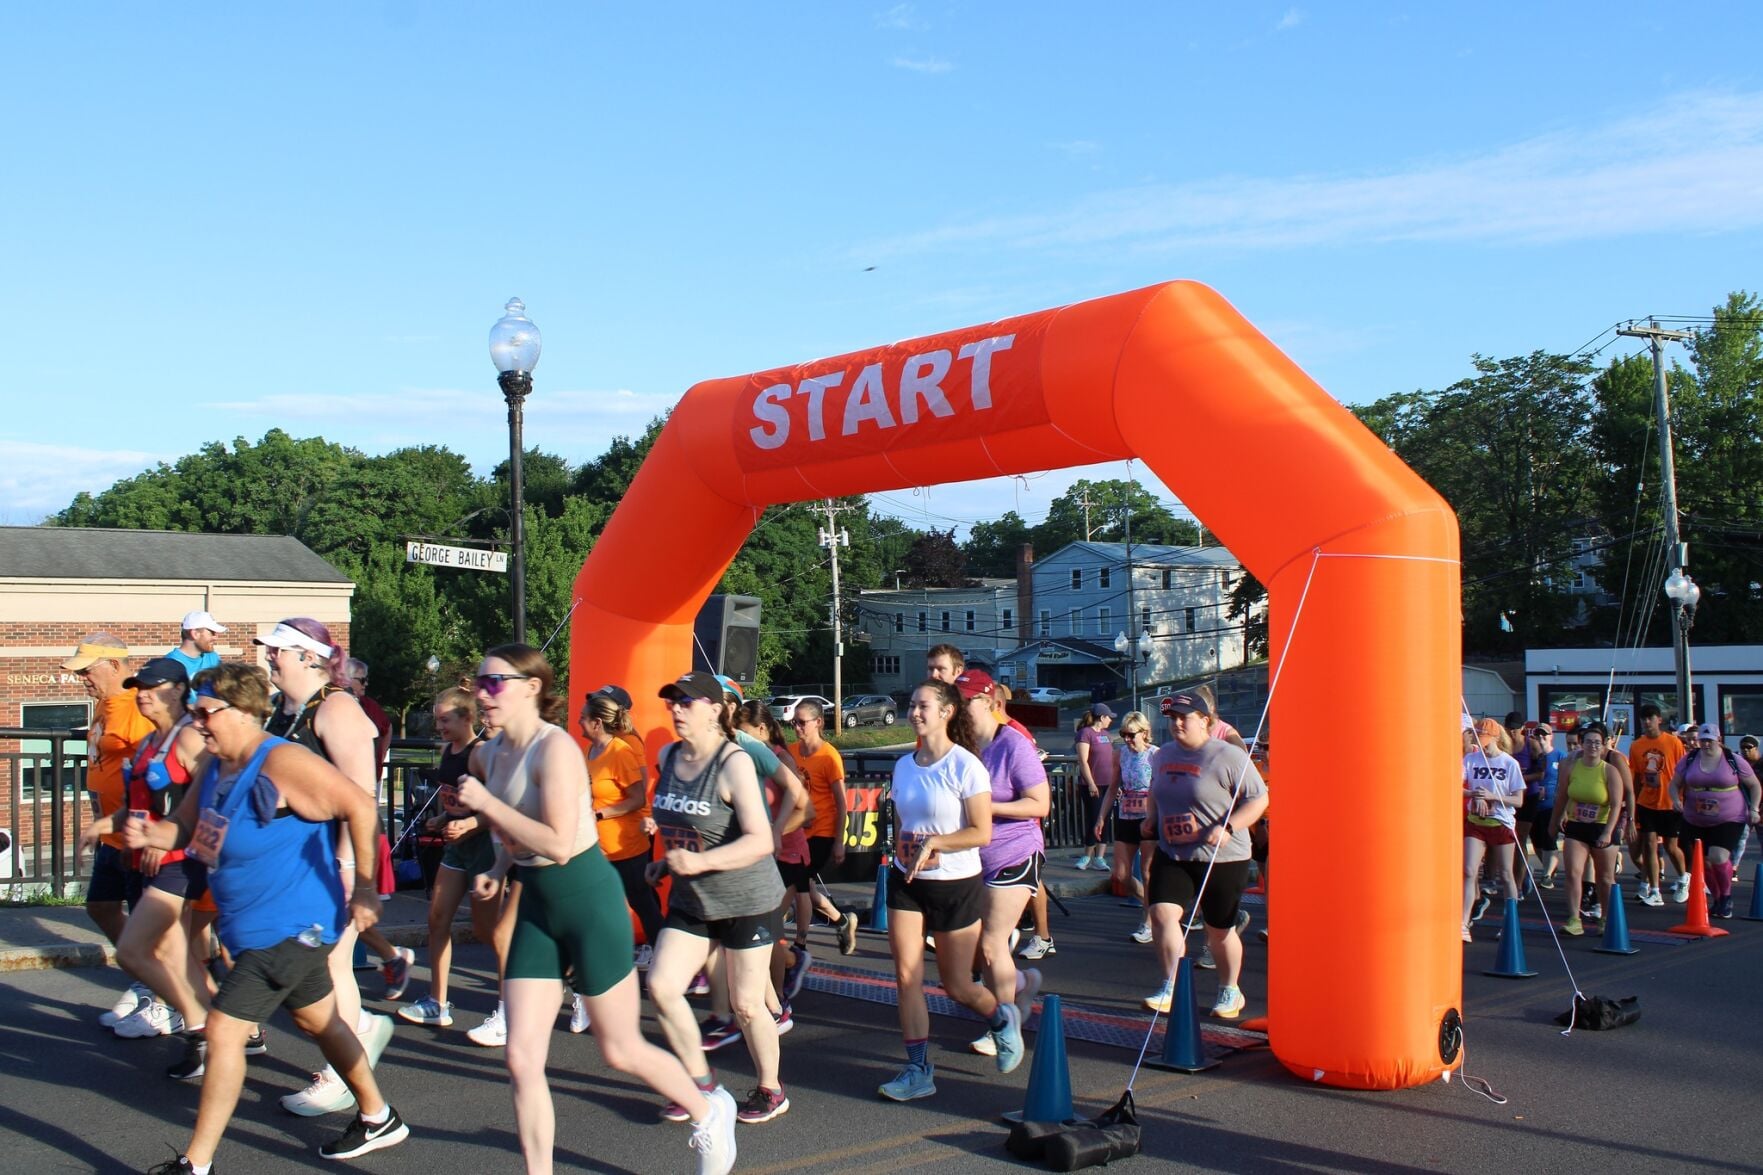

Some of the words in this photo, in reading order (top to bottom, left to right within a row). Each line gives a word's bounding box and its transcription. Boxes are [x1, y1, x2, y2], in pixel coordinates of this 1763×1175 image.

[750, 334, 1016, 450] START
[412, 545, 450, 563] GEORGE
[458, 550, 493, 568] BAILEY
[496, 555, 504, 563] LN
[7, 674, 56, 684] SENECA
[61, 674, 84, 684] FAL
[1473, 766, 1506, 781] 1973
[653, 793, 711, 816] adidas
[1167, 823, 1193, 836] 130
